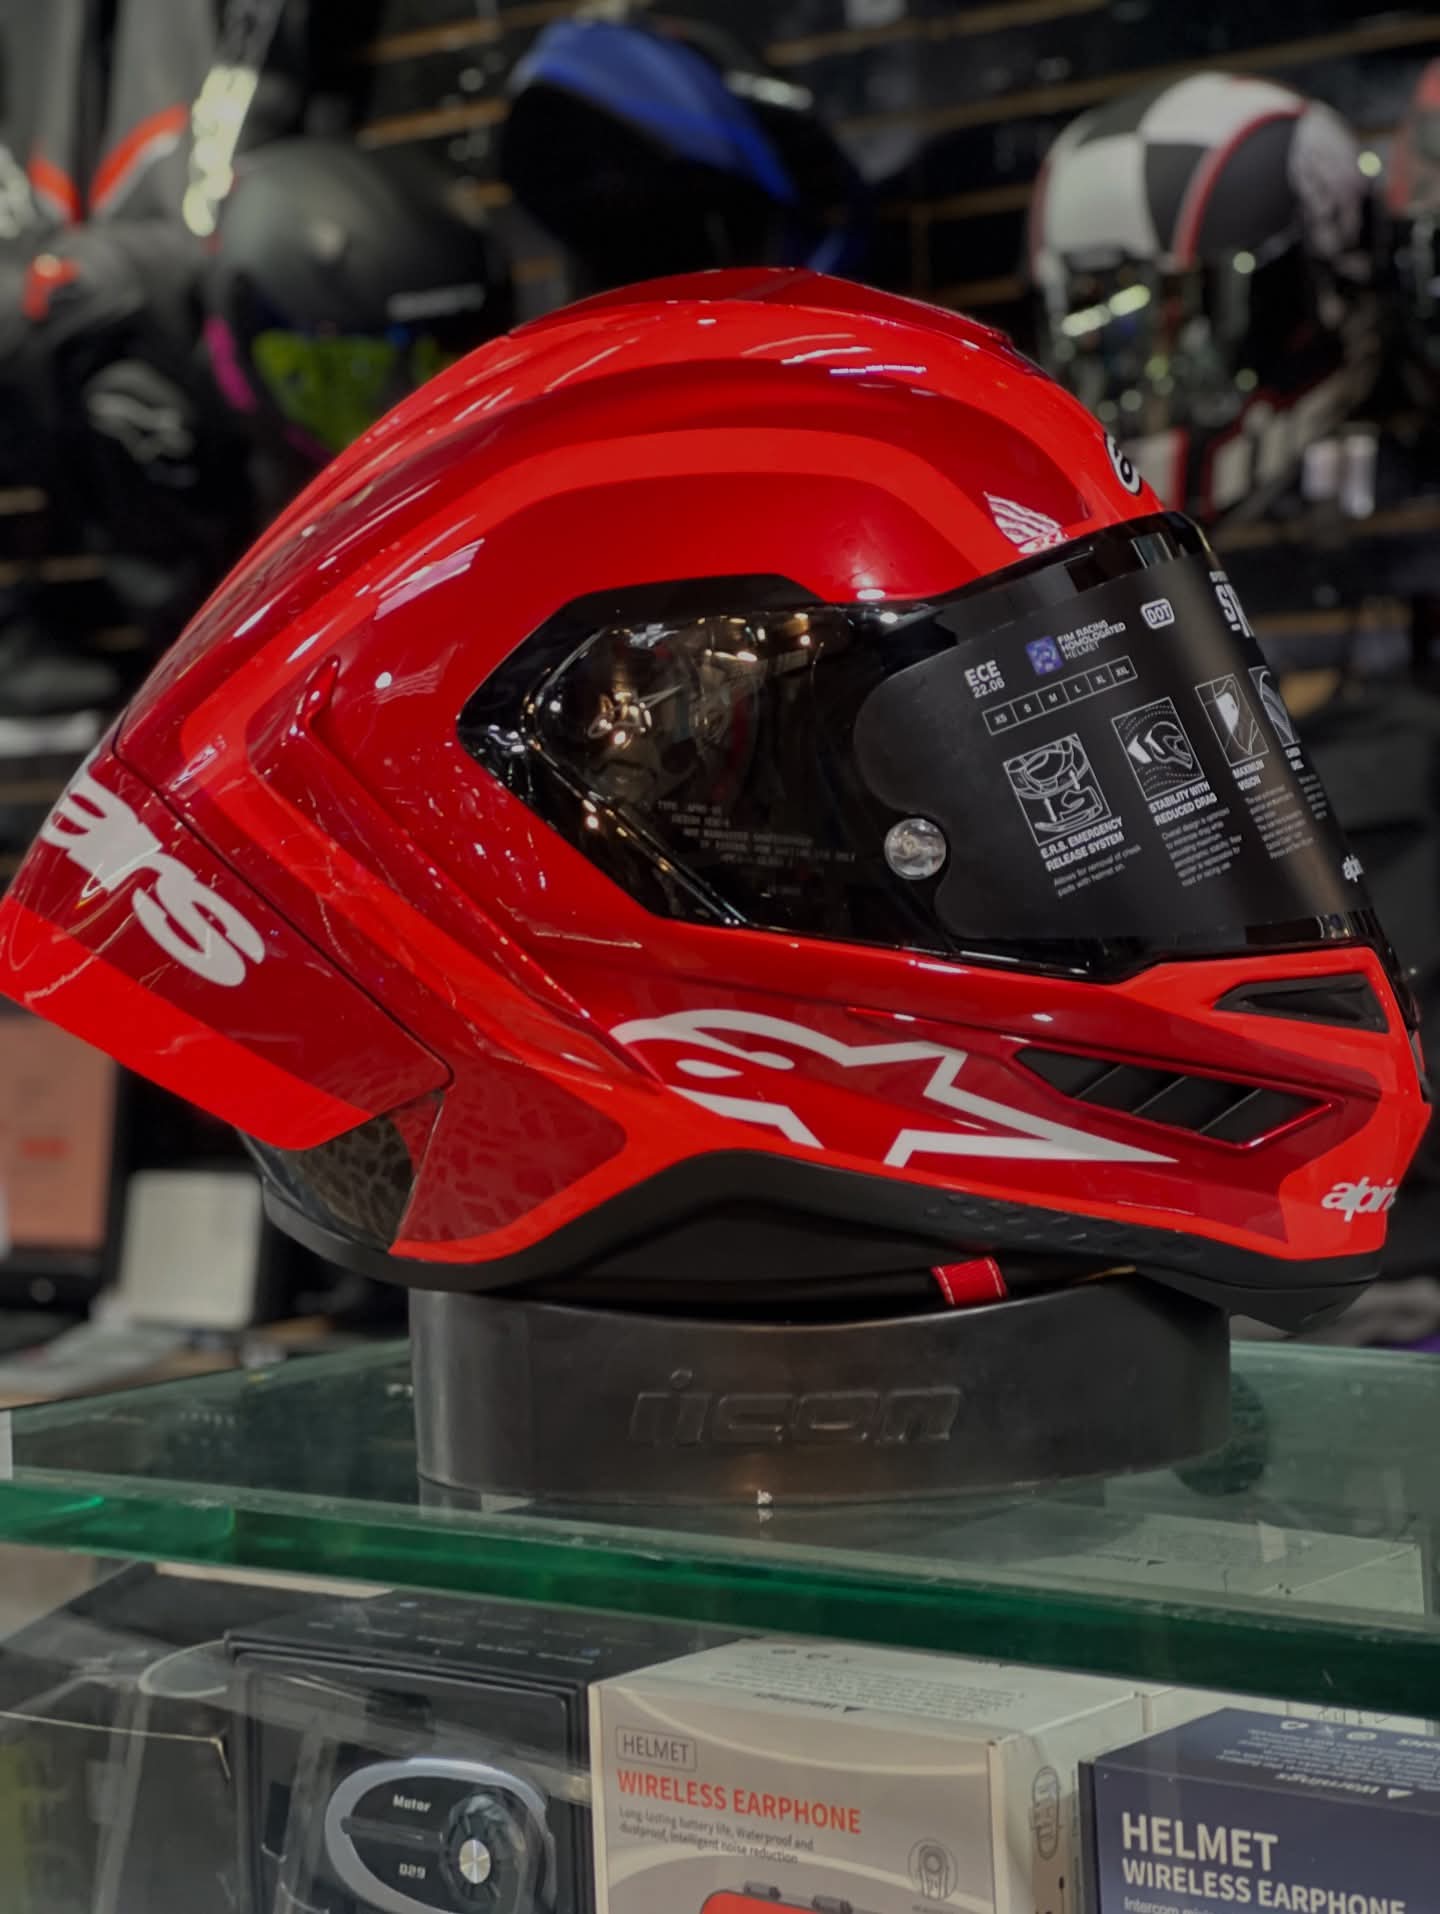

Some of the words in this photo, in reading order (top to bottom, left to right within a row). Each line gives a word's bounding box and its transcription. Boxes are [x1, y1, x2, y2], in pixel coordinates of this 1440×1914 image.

[1076, 620, 1109, 638] RACING
[1148, 606, 1171, 624] DOT
[1060, 622, 1126, 651] HOMOLOGATED
[1064, 641, 1100, 660] HELMET
[964, 660, 1001, 687] ECE
[1148, 789, 1190, 814] STABILITY
[1189, 781, 1210, 796] WITH
[1154, 801, 1195, 826] REDUCED
[1194, 792, 1217, 809] DRAG
[1067, 816, 1123, 847] EMERGENCY
[38, 740, 266, 988] ars
[1045, 846, 1088, 872] RELEASE
[1087, 831, 1125, 854] SYSTEM
[623, 1733, 689, 1763] HELMET
[393, 1793, 432, 1813] Motor
[617, 1769, 727, 1810] WIRELESS
[733, 1789, 861, 1834] EARPHONE
[794, 1839, 814, 1851] and
[1121, 1811, 1278, 1871] HELMET
[1121, 1858, 1251, 1903] WIRELESS
